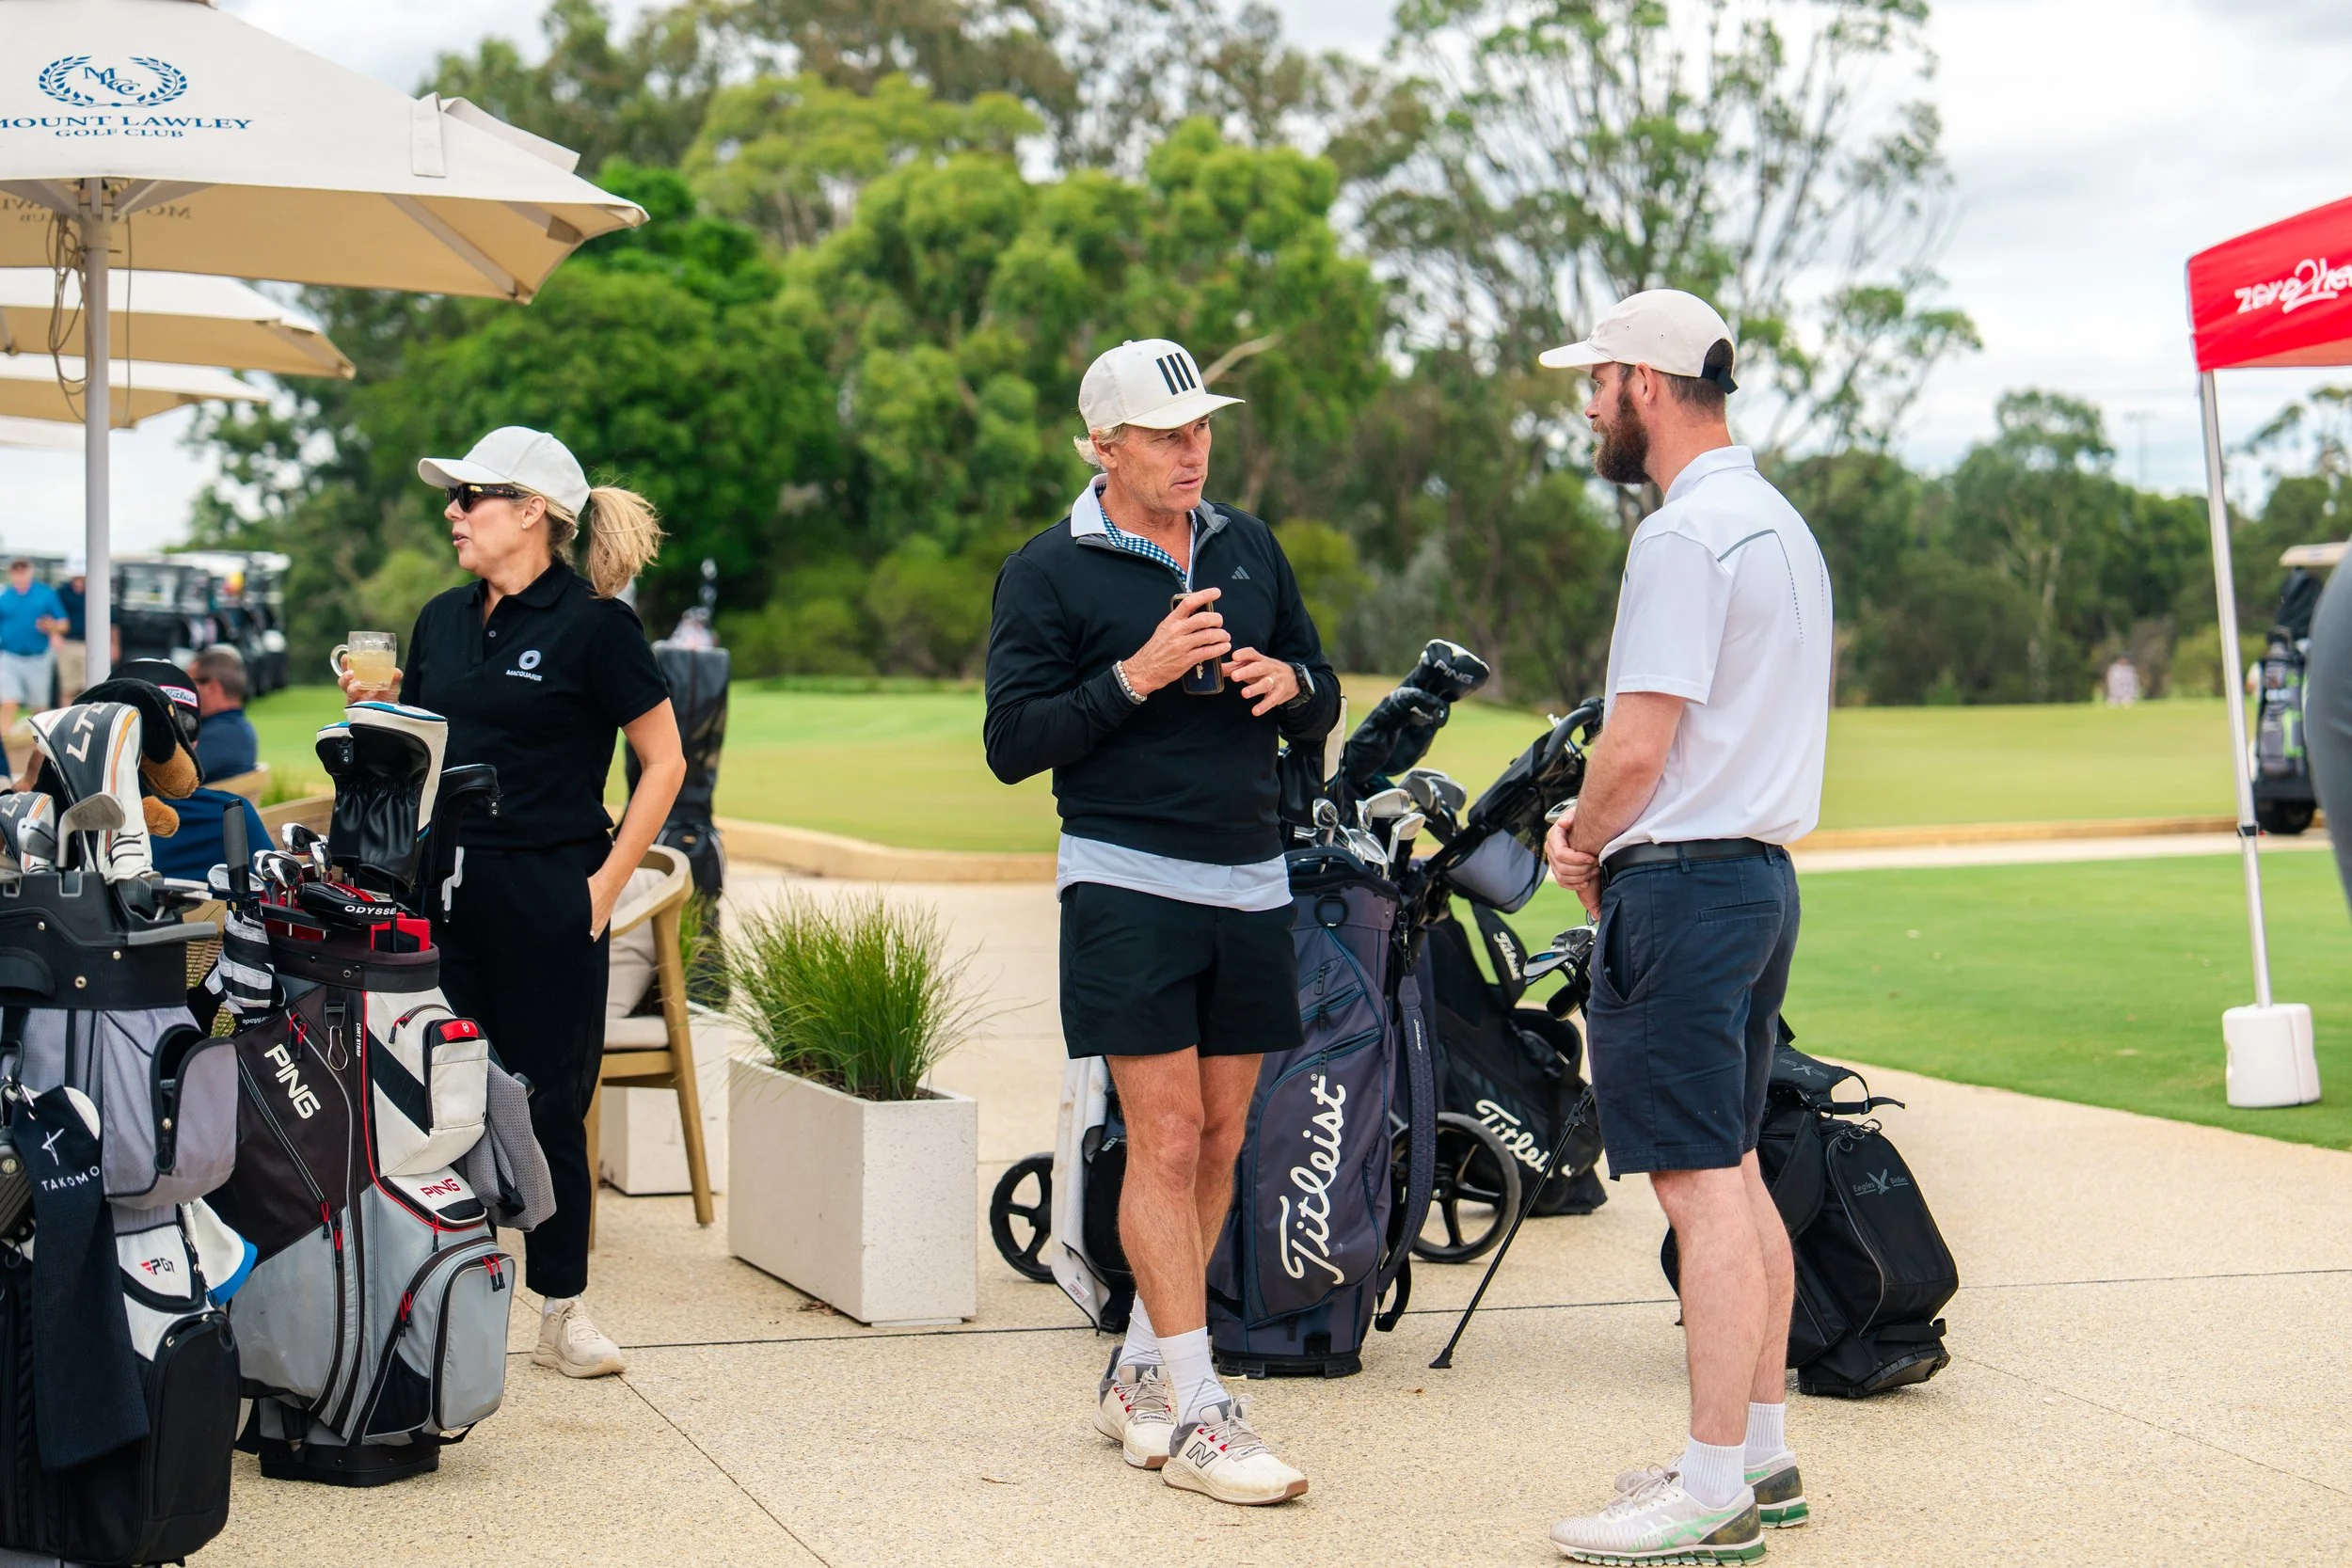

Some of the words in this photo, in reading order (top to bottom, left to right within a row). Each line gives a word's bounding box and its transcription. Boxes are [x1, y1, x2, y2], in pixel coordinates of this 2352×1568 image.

[55, 128, 119, 137] GOLF
[123, 128, 184, 138] CLUB
[121, 116, 254, 130] LAWLEY
[1434, 658, 1474, 685] PING
[344, 904, 397, 915] ODYSSE
[263, 1043, 322, 1119] PING
[41, 1165, 101, 1192] TAKOMO
[420, 1178, 461, 1198] PING
[1279, 1074, 1347, 1285] Titleist
